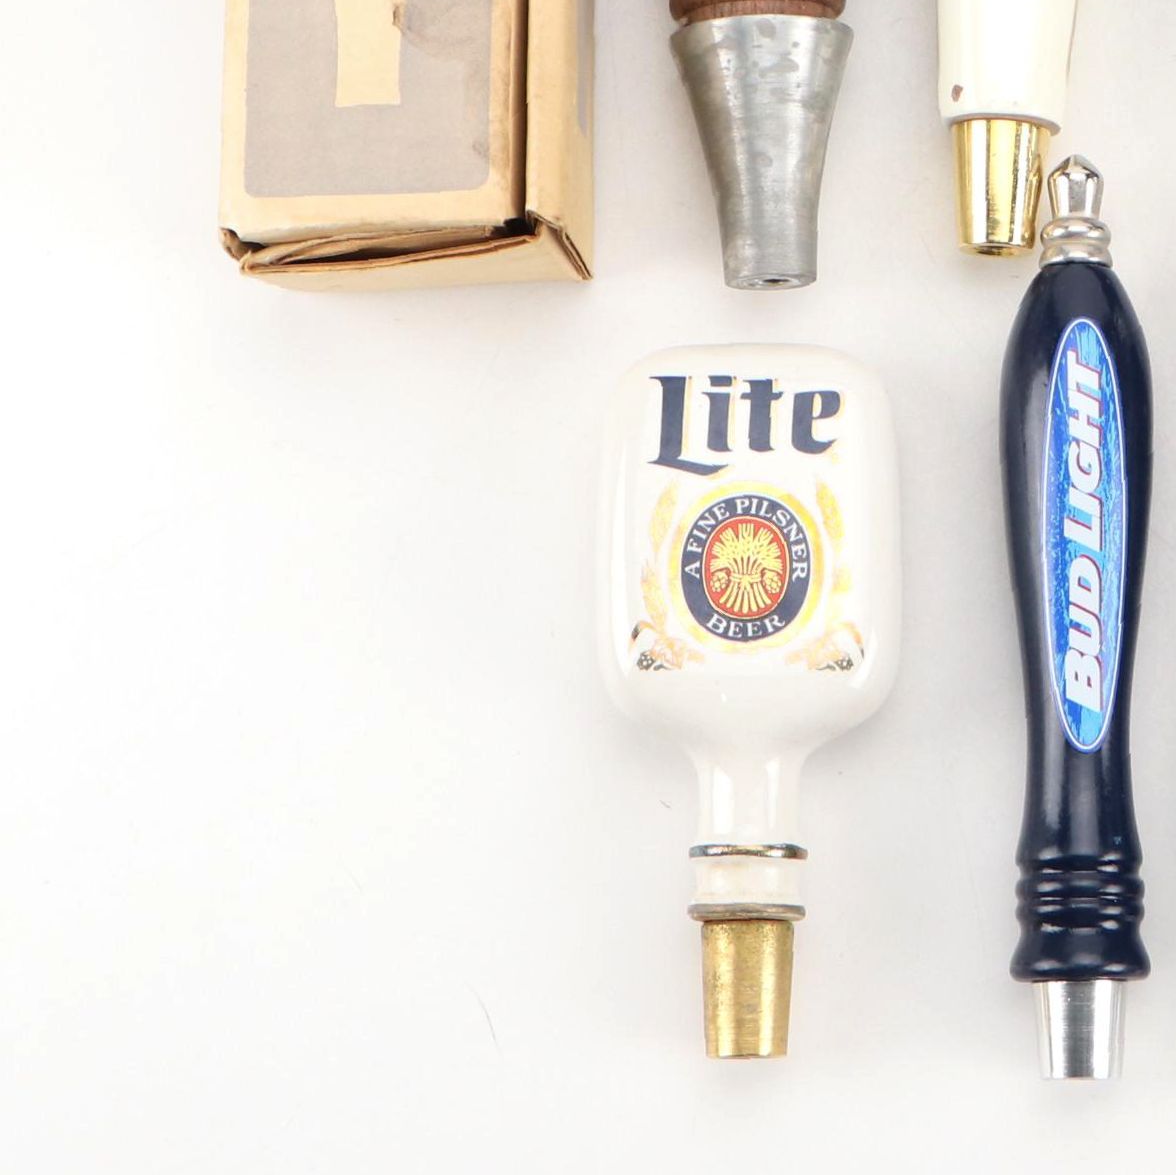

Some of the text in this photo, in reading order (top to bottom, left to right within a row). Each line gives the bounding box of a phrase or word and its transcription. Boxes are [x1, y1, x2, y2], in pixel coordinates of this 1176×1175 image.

[646, 374, 842, 476] Lite
[684, 497, 808, 582] A FINE PILSNER
[1063, 350, 1105, 712] BUD LIGHT
[705, 612, 787, 639] BEER
